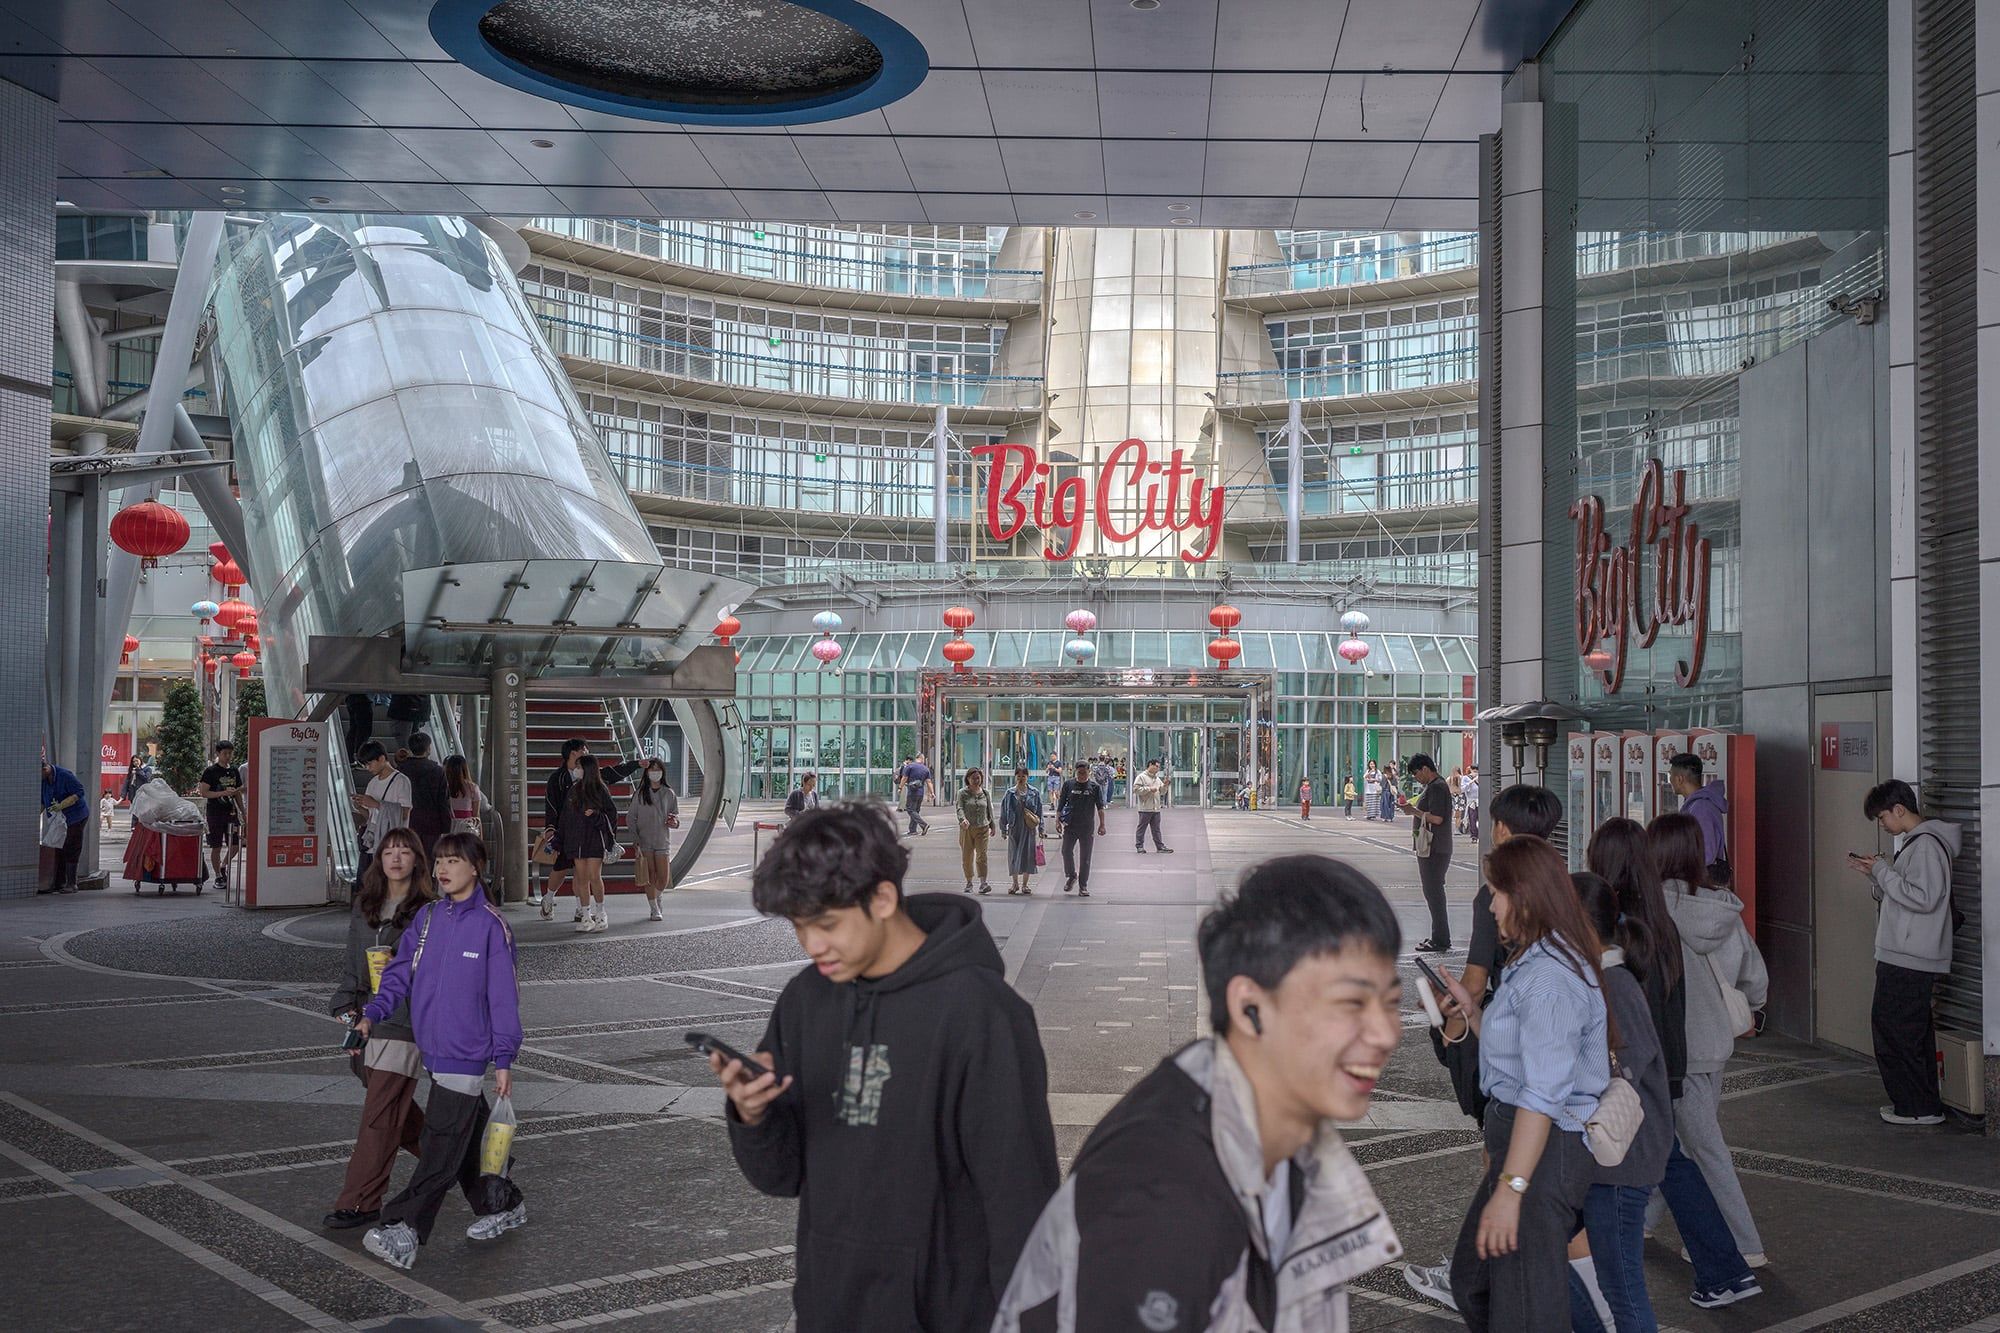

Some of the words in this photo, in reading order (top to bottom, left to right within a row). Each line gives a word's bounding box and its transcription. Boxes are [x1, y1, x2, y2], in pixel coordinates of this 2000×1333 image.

[971, 443, 1086, 560] Big
[1096, 438, 1225, 562] City
[1568, 495, 1629, 694] Big
[1627, 458, 1712, 688] City
[101, 744, 117, 760] City
[1825, 736, 1837, 756] 1F
